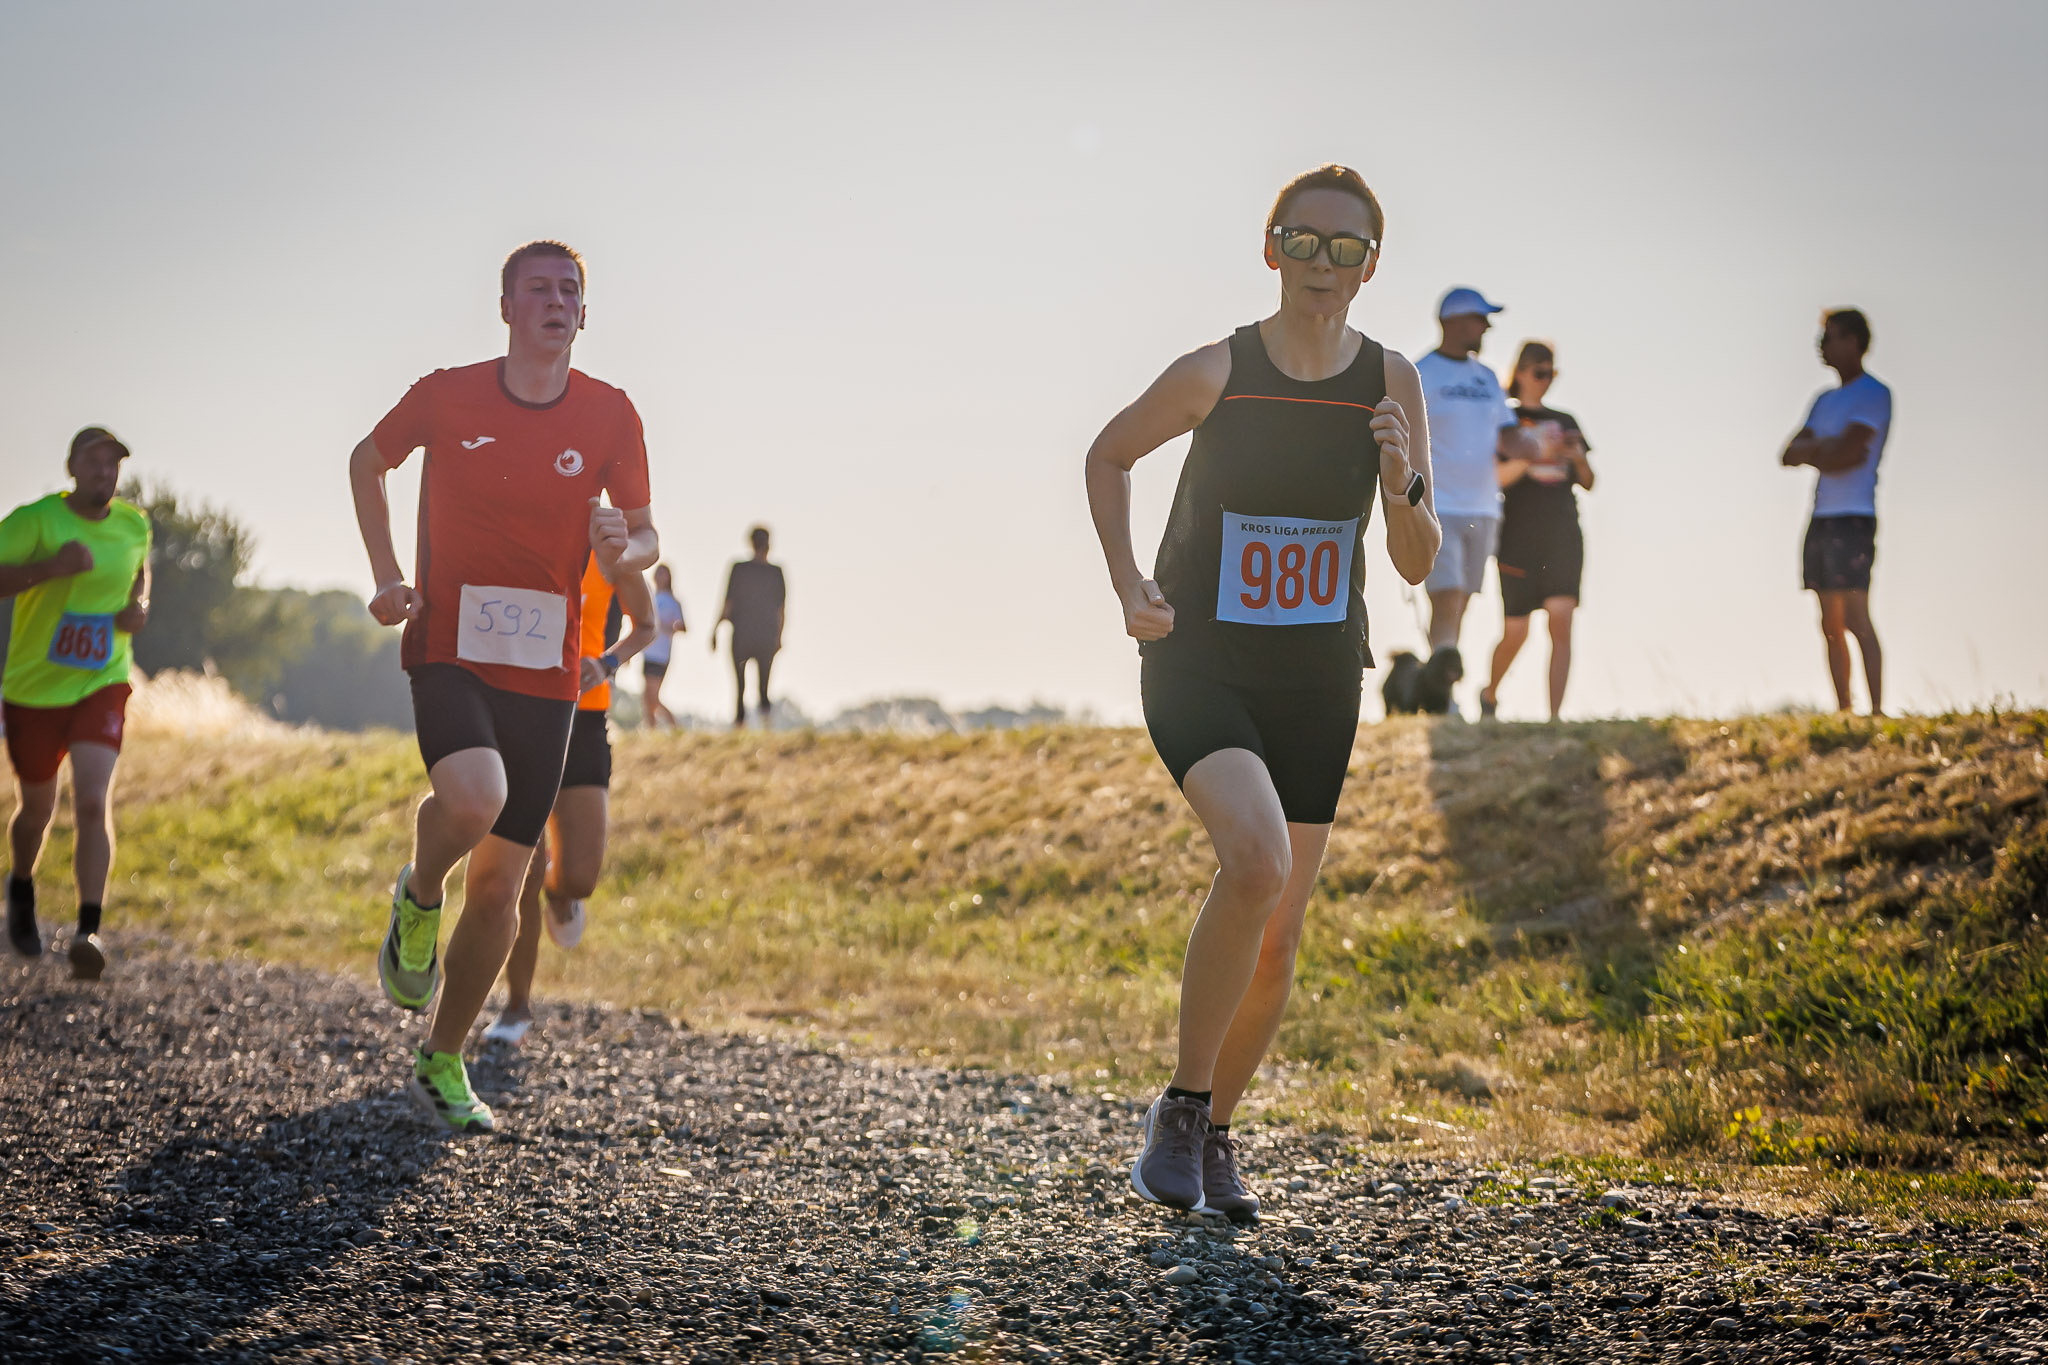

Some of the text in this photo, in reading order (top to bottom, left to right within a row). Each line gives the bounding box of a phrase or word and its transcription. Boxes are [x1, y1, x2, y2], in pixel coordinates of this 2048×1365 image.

[1240, 522, 1343, 536] KROS LIGA PRELOG
[1240, 540, 1340, 610] 980
[474, 600, 547, 640] 592
[56, 624, 107, 661] 863
